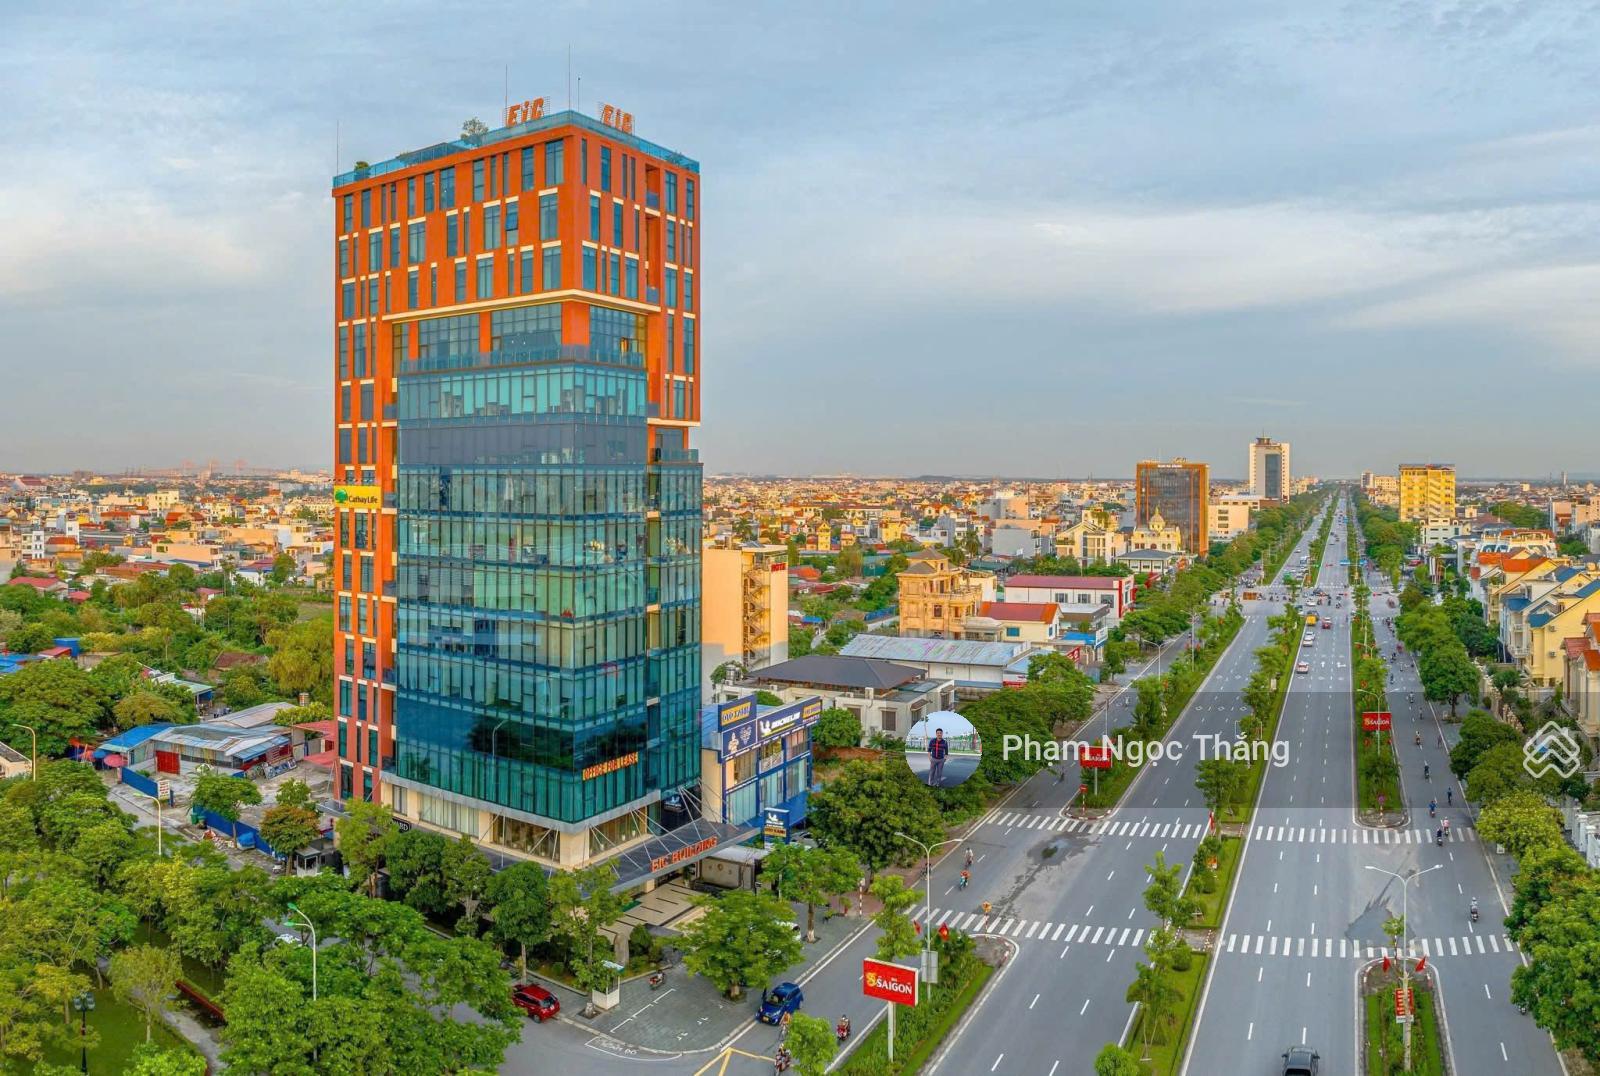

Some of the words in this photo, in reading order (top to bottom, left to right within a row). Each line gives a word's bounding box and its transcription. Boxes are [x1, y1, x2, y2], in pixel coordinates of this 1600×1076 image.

[349, 495, 366, 504] Cathay
[651, 857, 669, 872] EIC
[671, 836, 718, 865] BUILDING
[876, 978, 913, 995] SAIGON
